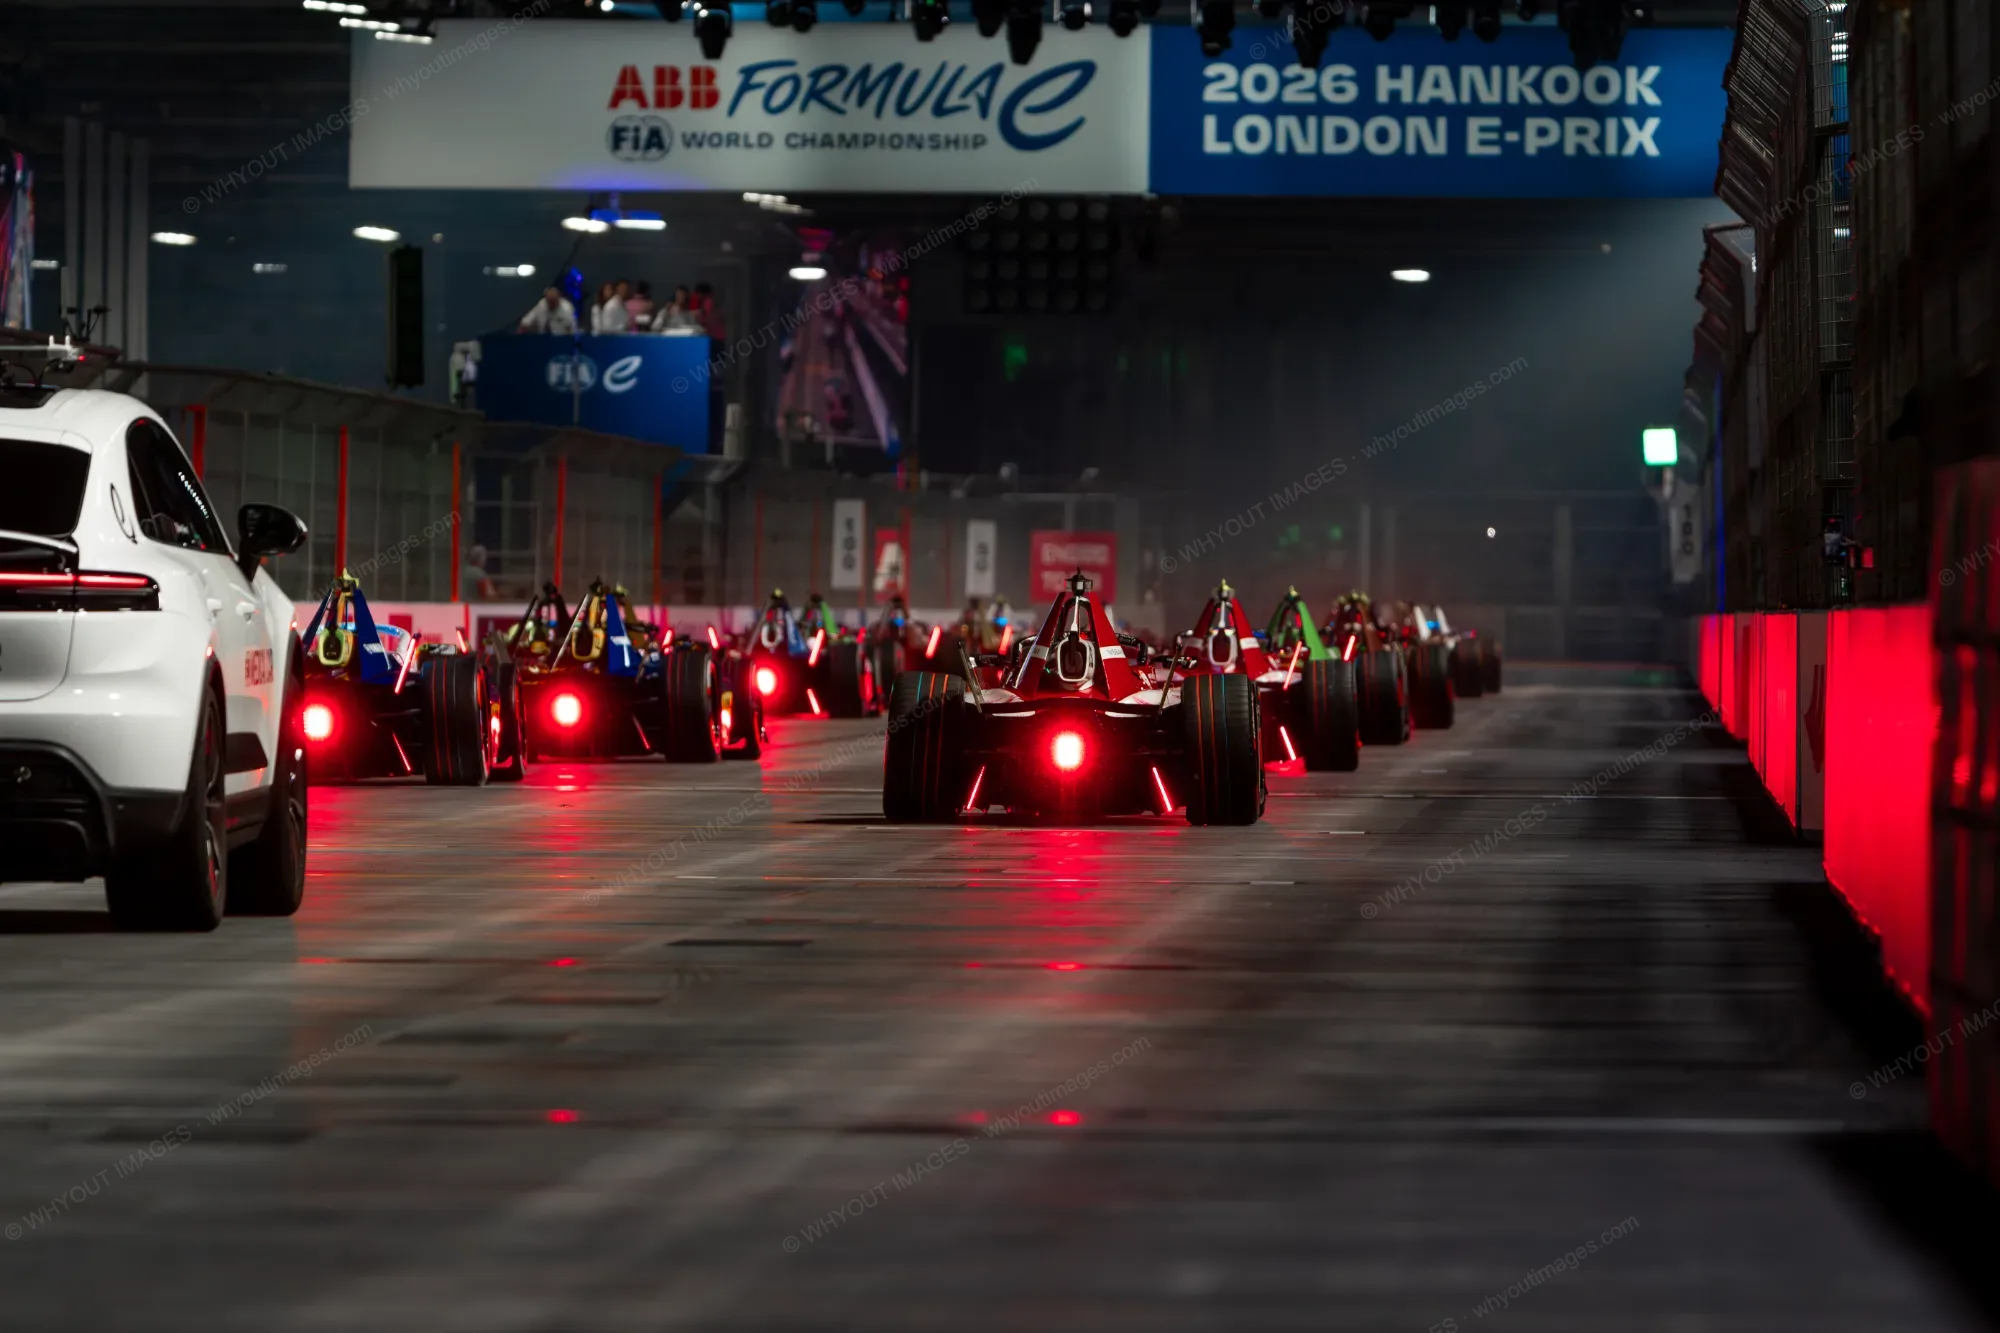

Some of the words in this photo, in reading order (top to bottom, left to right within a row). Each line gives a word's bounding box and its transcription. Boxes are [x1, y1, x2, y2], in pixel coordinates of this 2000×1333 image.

[607, 64, 720, 110] ABB
[727, 59, 1005, 120] FORMULA
[1202, 62, 1359, 104] 2026
[1375, 64, 1663, 106] HANKOOK
[681, 131, 774, 151] WORLD
[783, 131, 988, 151] CHAMPIONSHIP
[1202, 113, 1448, 156] LONDON
[1465, 116, 1662, 157] E-PRIX
